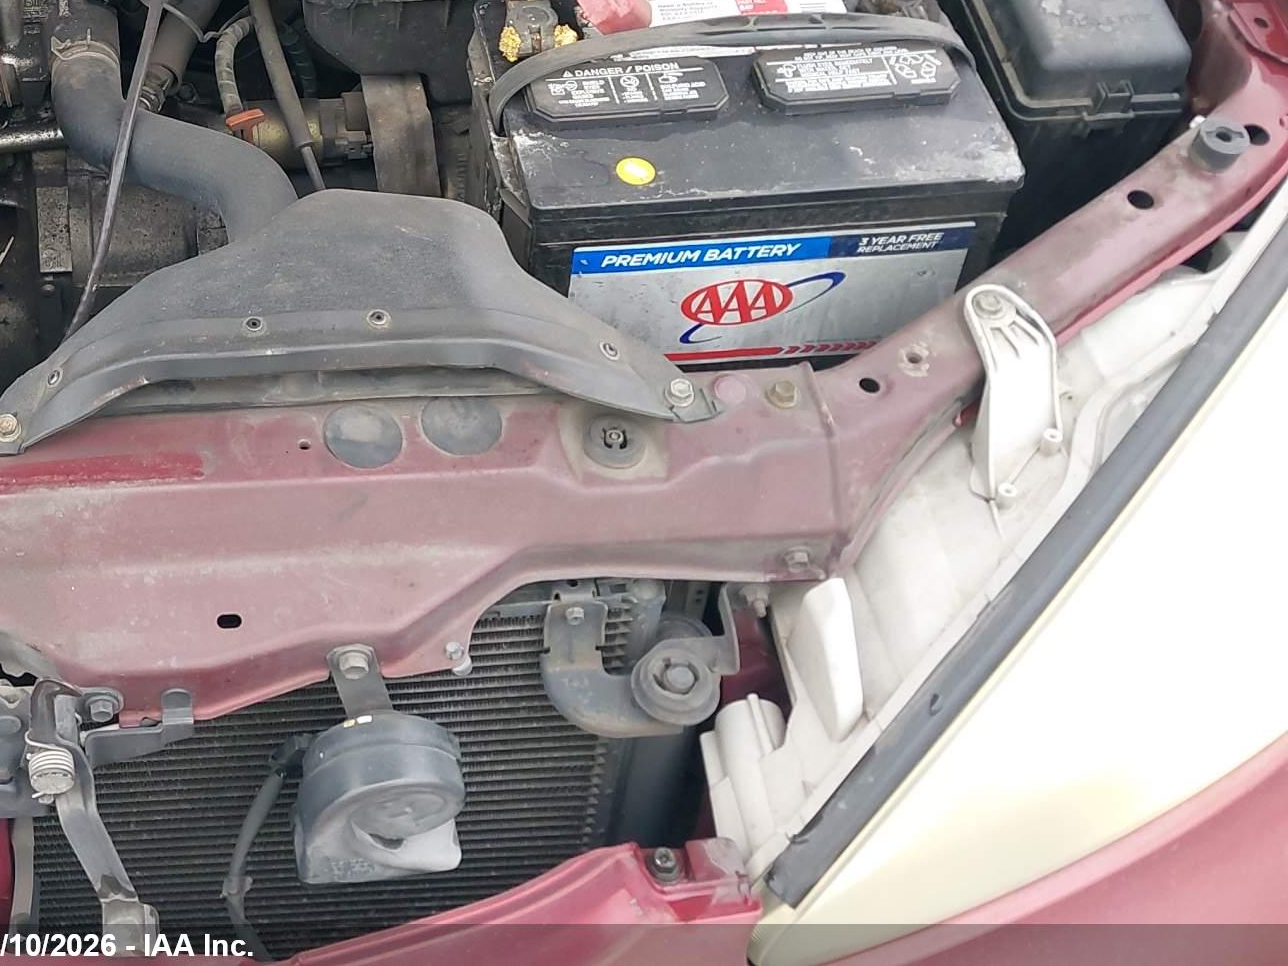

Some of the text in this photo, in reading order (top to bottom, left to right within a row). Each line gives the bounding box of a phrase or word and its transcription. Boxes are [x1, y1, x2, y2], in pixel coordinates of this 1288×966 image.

[574, 67, 624, 77] DANGER
[634, 62, 680, 73] POISON
[858, 232, 945, 246] 3 YEAR FREE
[856, 241, 937, 253] REPLACEMENT
[601, 242, 802, 268] PREMIUM BATTERY
[690, 280, 782, 324] AAA
